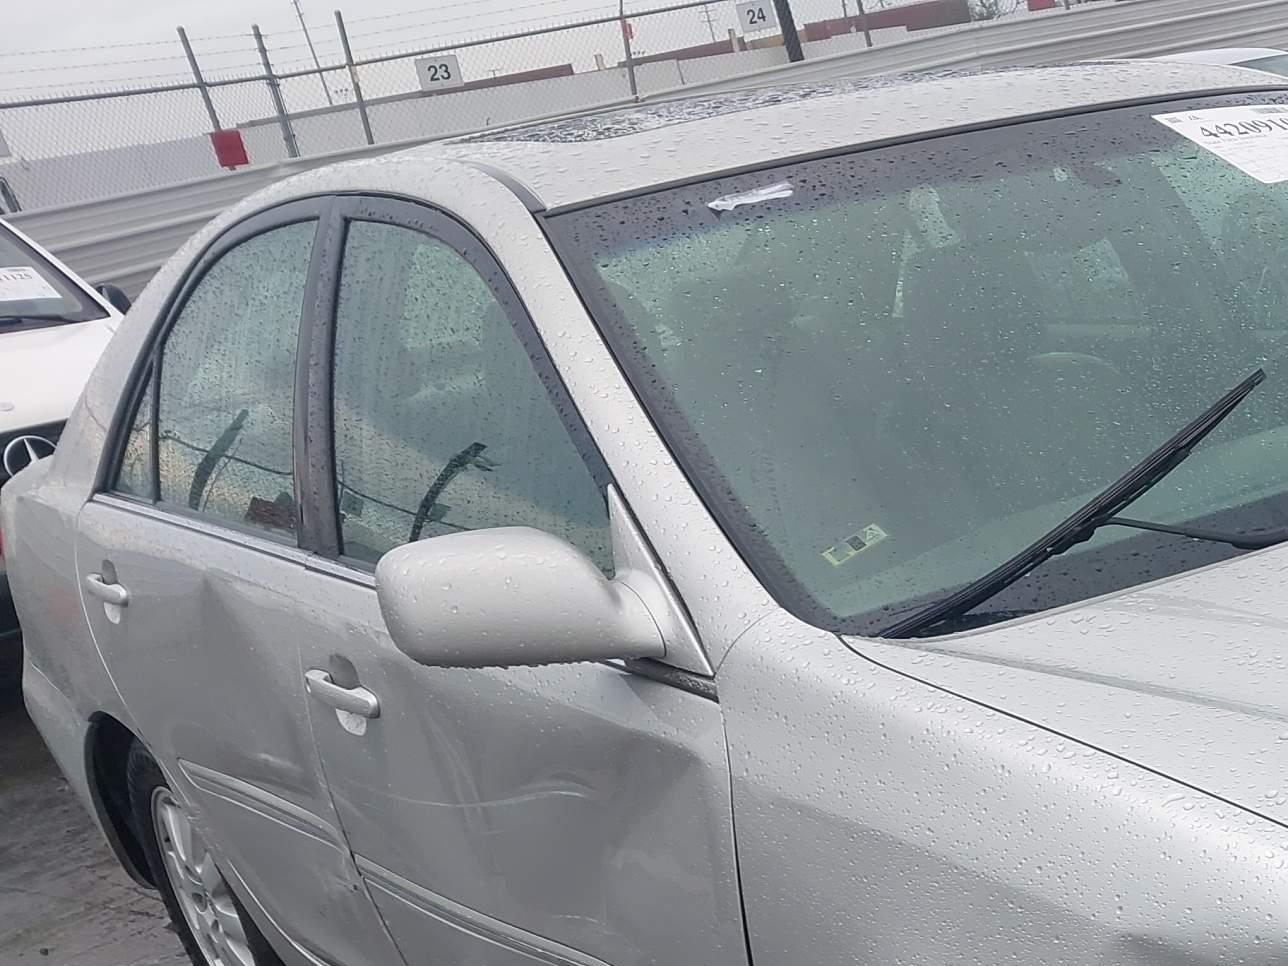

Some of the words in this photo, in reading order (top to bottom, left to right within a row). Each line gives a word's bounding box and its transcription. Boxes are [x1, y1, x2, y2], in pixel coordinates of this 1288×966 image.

[746, 7, 767, 25] 24
[427, 63, 451, 82] 23
[0, 272, 33, 281] 1125
